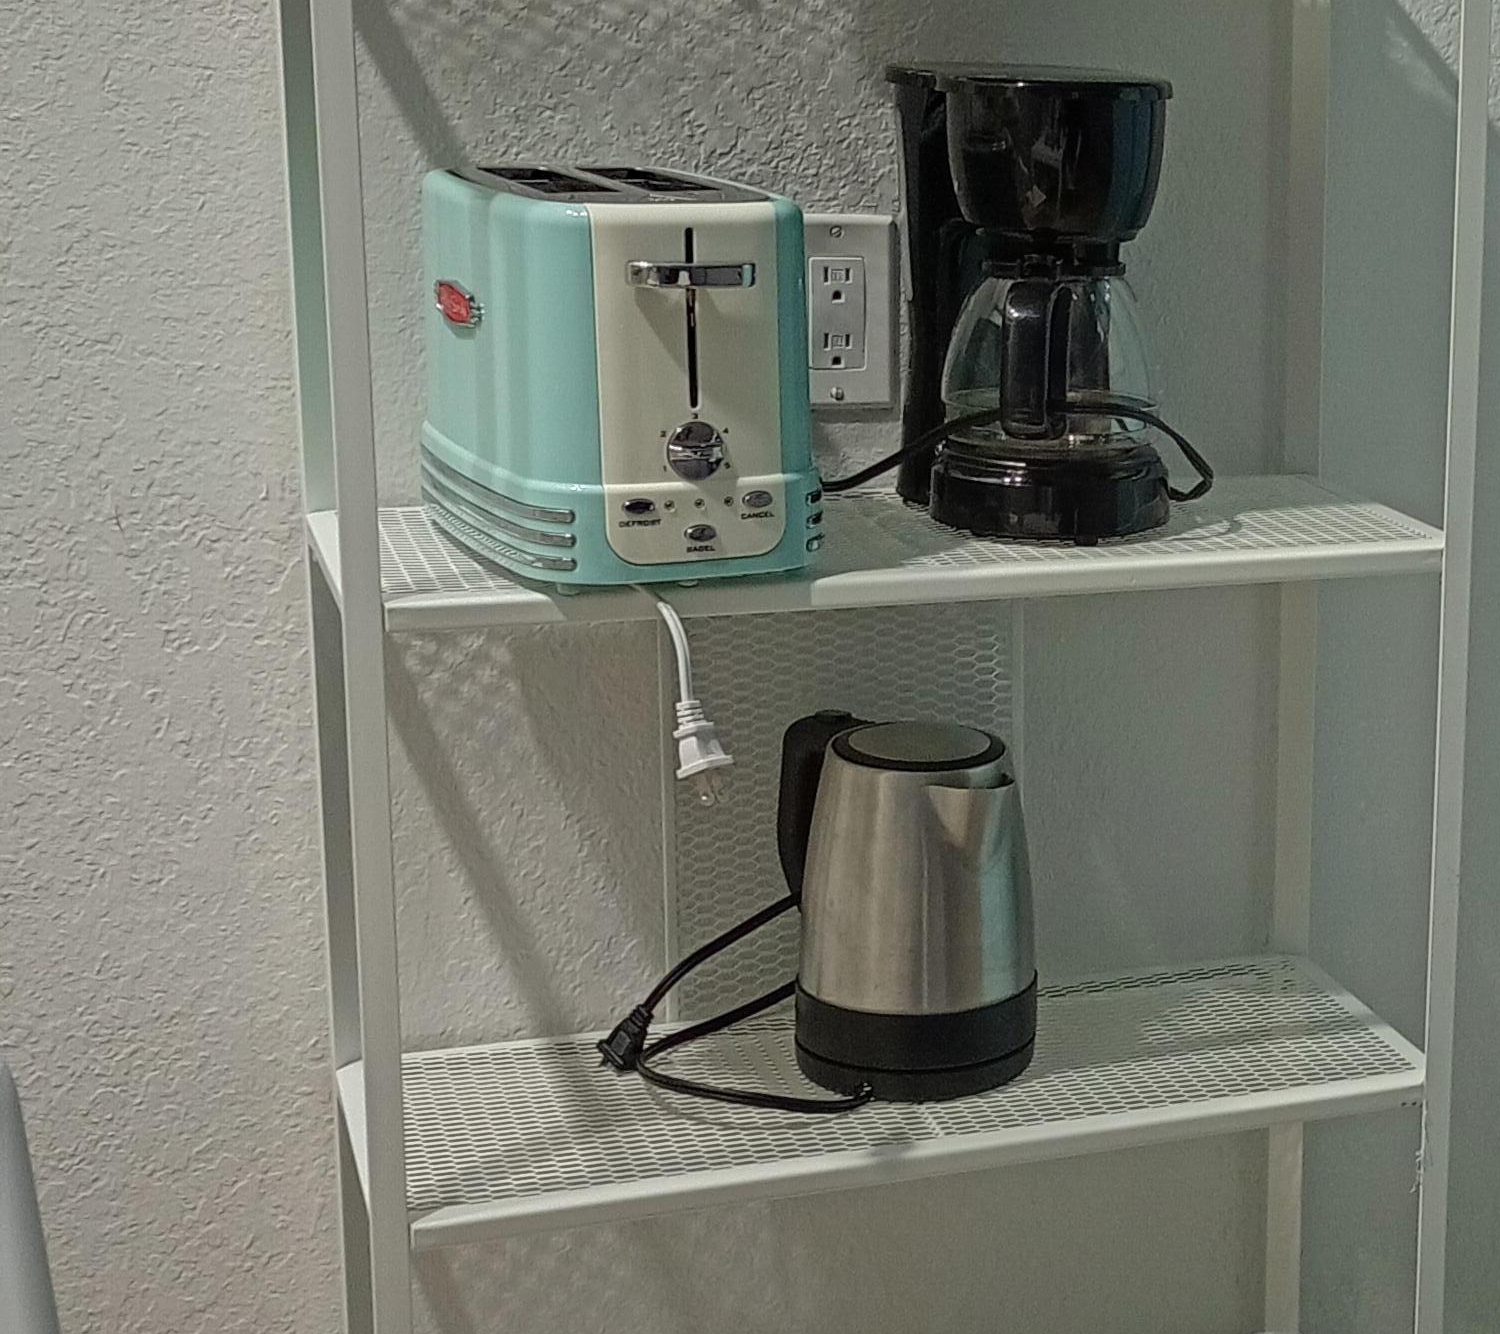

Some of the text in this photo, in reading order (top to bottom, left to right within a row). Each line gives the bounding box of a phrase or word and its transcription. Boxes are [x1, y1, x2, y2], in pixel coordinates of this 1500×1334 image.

[741, 512, 775, 520] CANCEL
[619, 519, 661, 528] DEFROST
[687, 545, 715, 553] BAGEL
